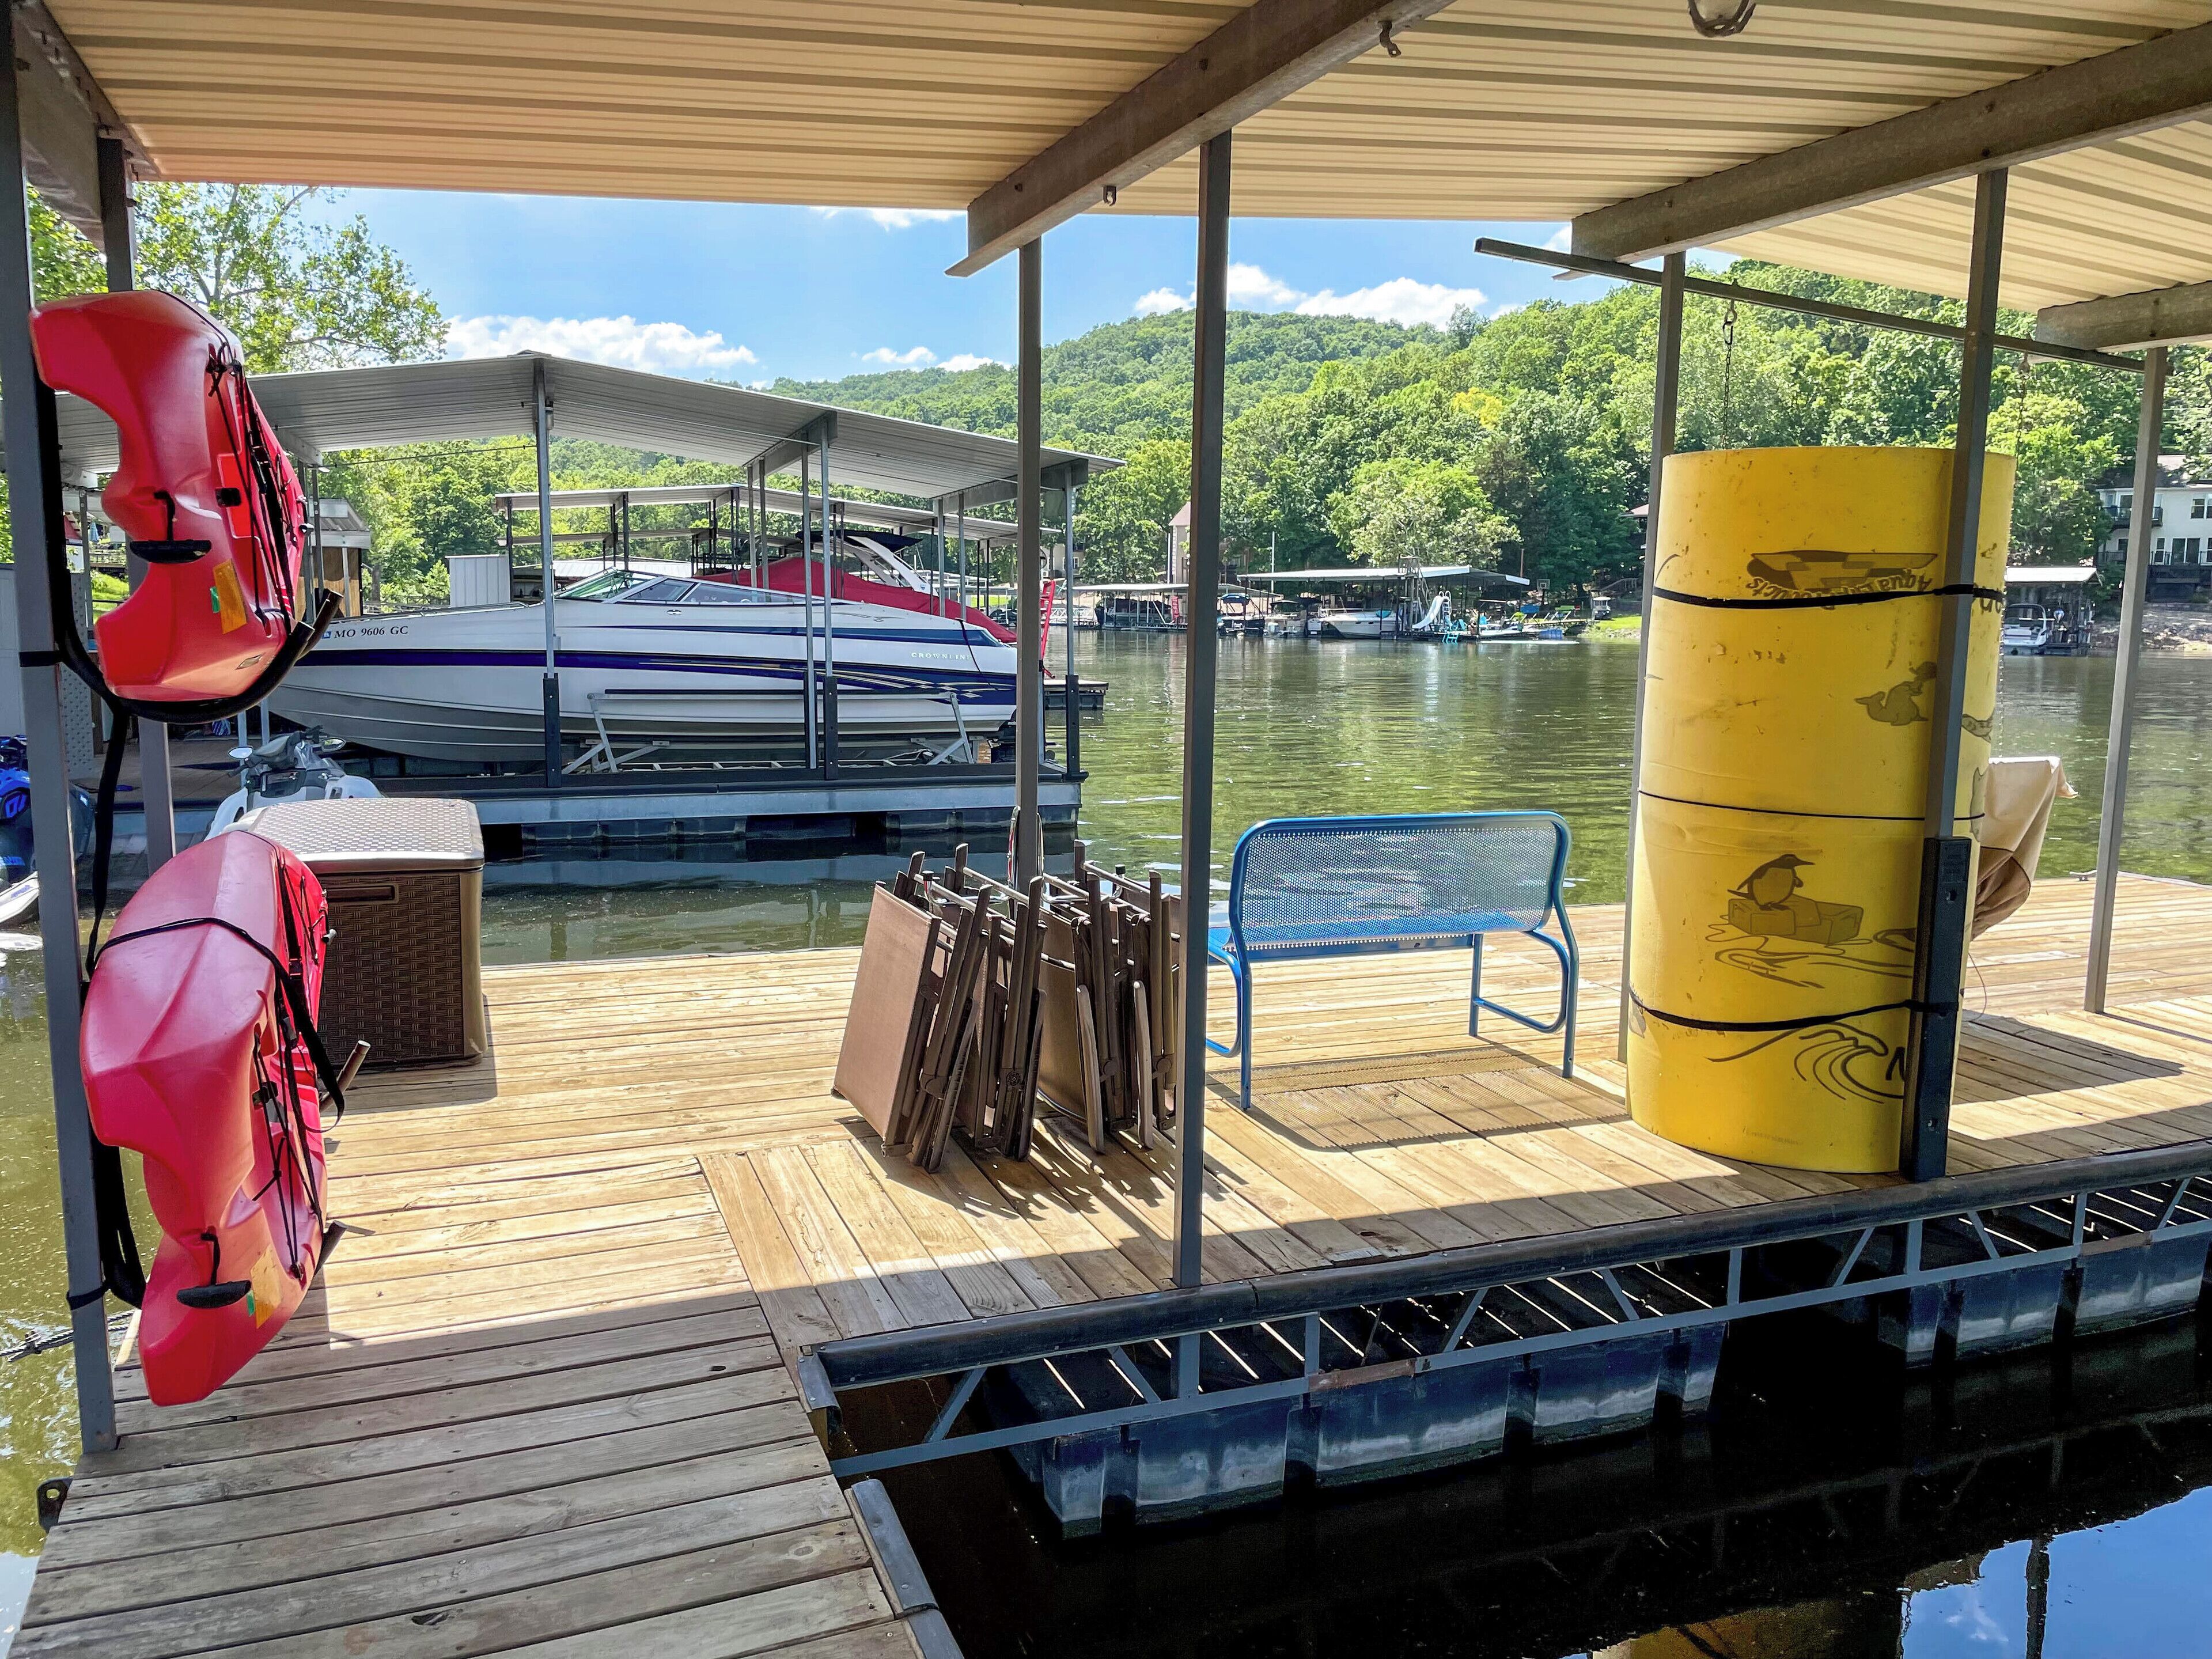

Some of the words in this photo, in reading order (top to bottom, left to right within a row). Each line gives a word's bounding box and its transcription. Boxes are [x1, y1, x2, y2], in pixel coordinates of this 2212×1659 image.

[1878, 570, 1933, 592] Aqua
[334, 629, 356, 638] MO
[361, 627, 385, 636] 9606
[390, 626, 408, 635] GC
